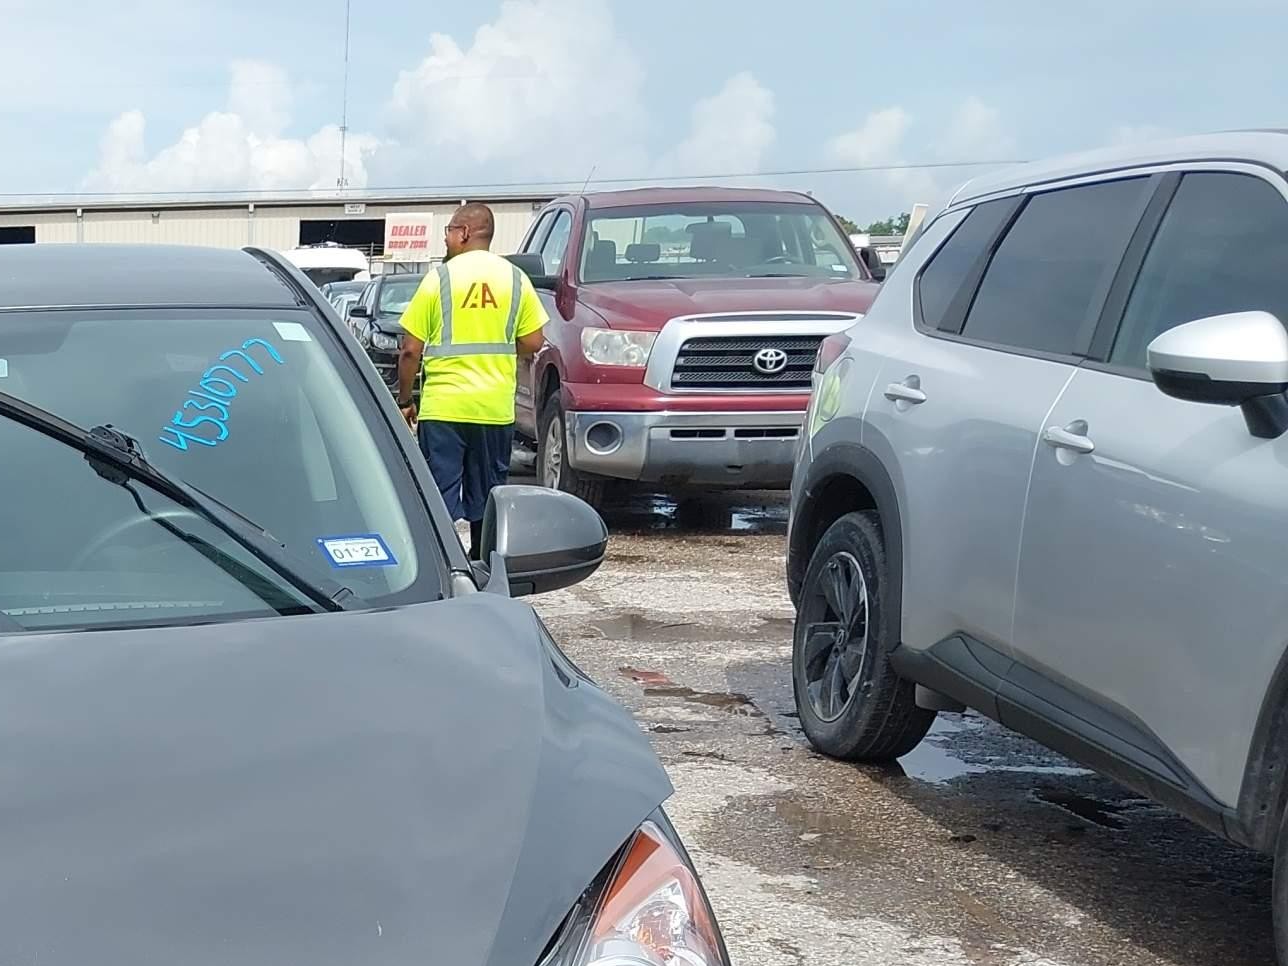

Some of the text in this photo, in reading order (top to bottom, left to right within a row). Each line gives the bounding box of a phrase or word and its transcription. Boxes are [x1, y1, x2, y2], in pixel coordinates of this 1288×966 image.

[391, 225, 427, 236] DEALER
[388, 240, 428, 249] DROP ZONE
[159, 338, 285, 451] 45310777
